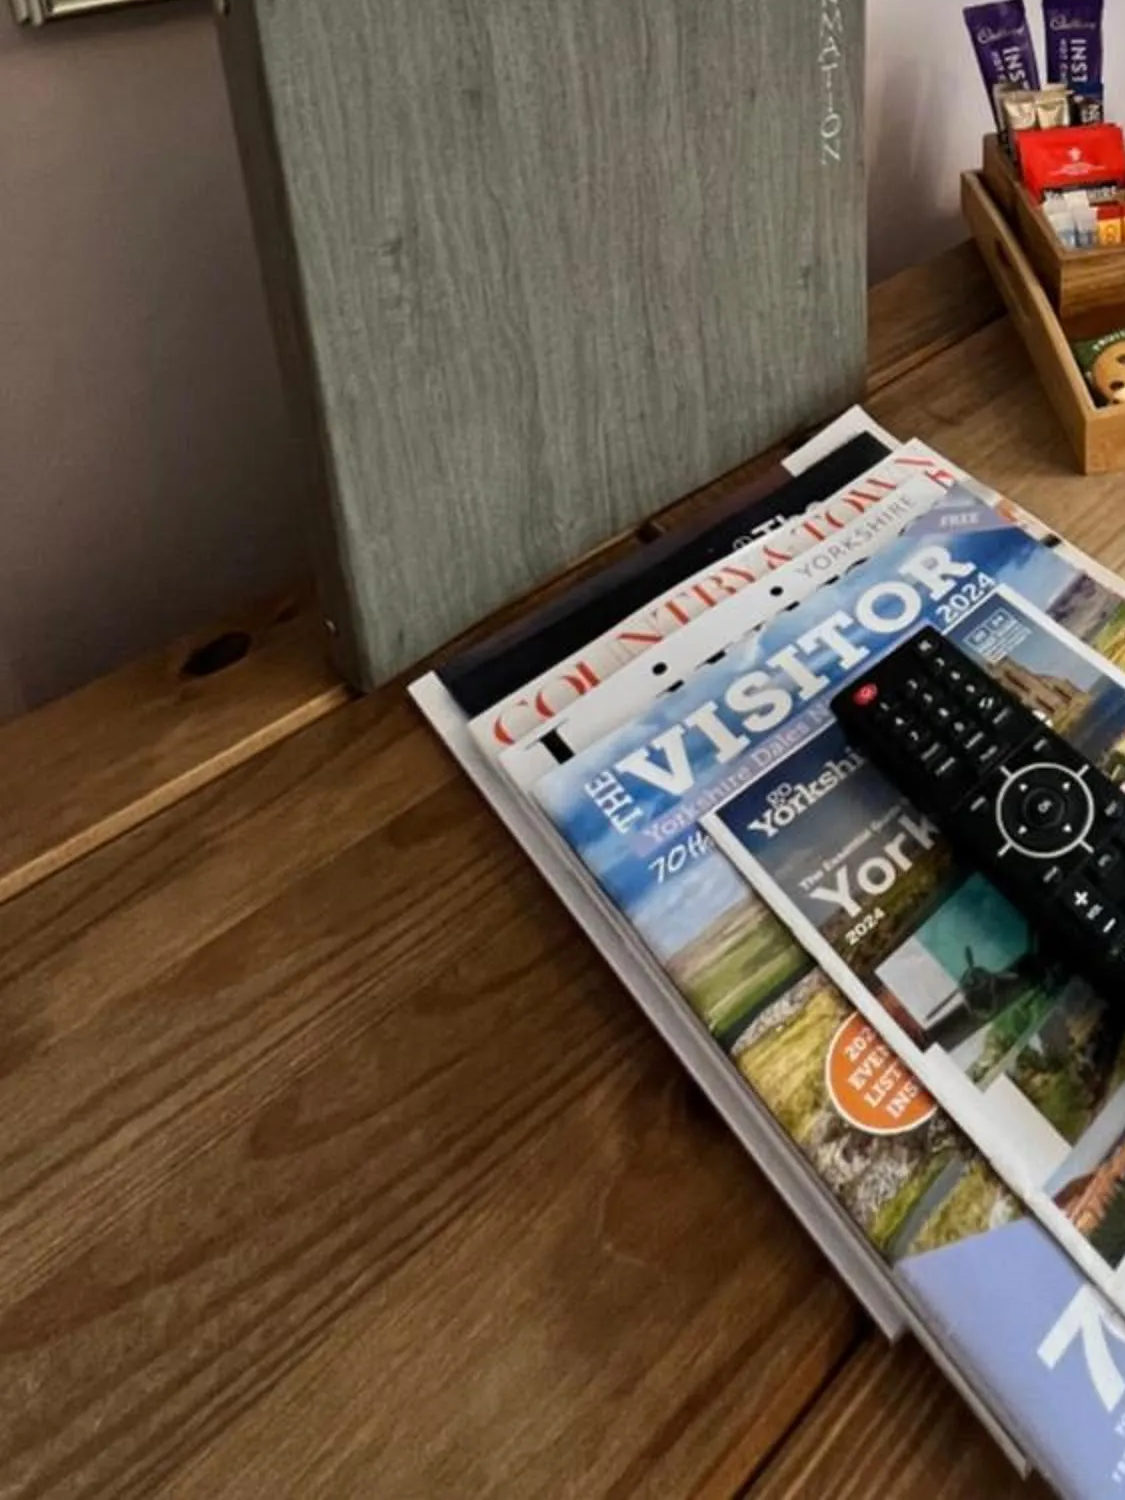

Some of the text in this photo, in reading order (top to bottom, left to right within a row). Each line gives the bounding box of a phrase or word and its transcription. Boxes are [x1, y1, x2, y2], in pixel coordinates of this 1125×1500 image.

[796, 496, 916, 580] YORKSHIRE
[493, 558, 757, 746] COUNTRY
[614, 544, 997, 796] VISITOR 2024
[584, 769, 645, 835] THE
[643, 767, 752, 844] Yorkshire
[755, 723, 811, 769] Dales
[747, 746, 866, 838] Yorkshi
[766, 782, 793, 810] go
[810, 813, 941, 919] York
[844, 907, 886, 946] 2024
[845, 1025, 876, 1062] 202
